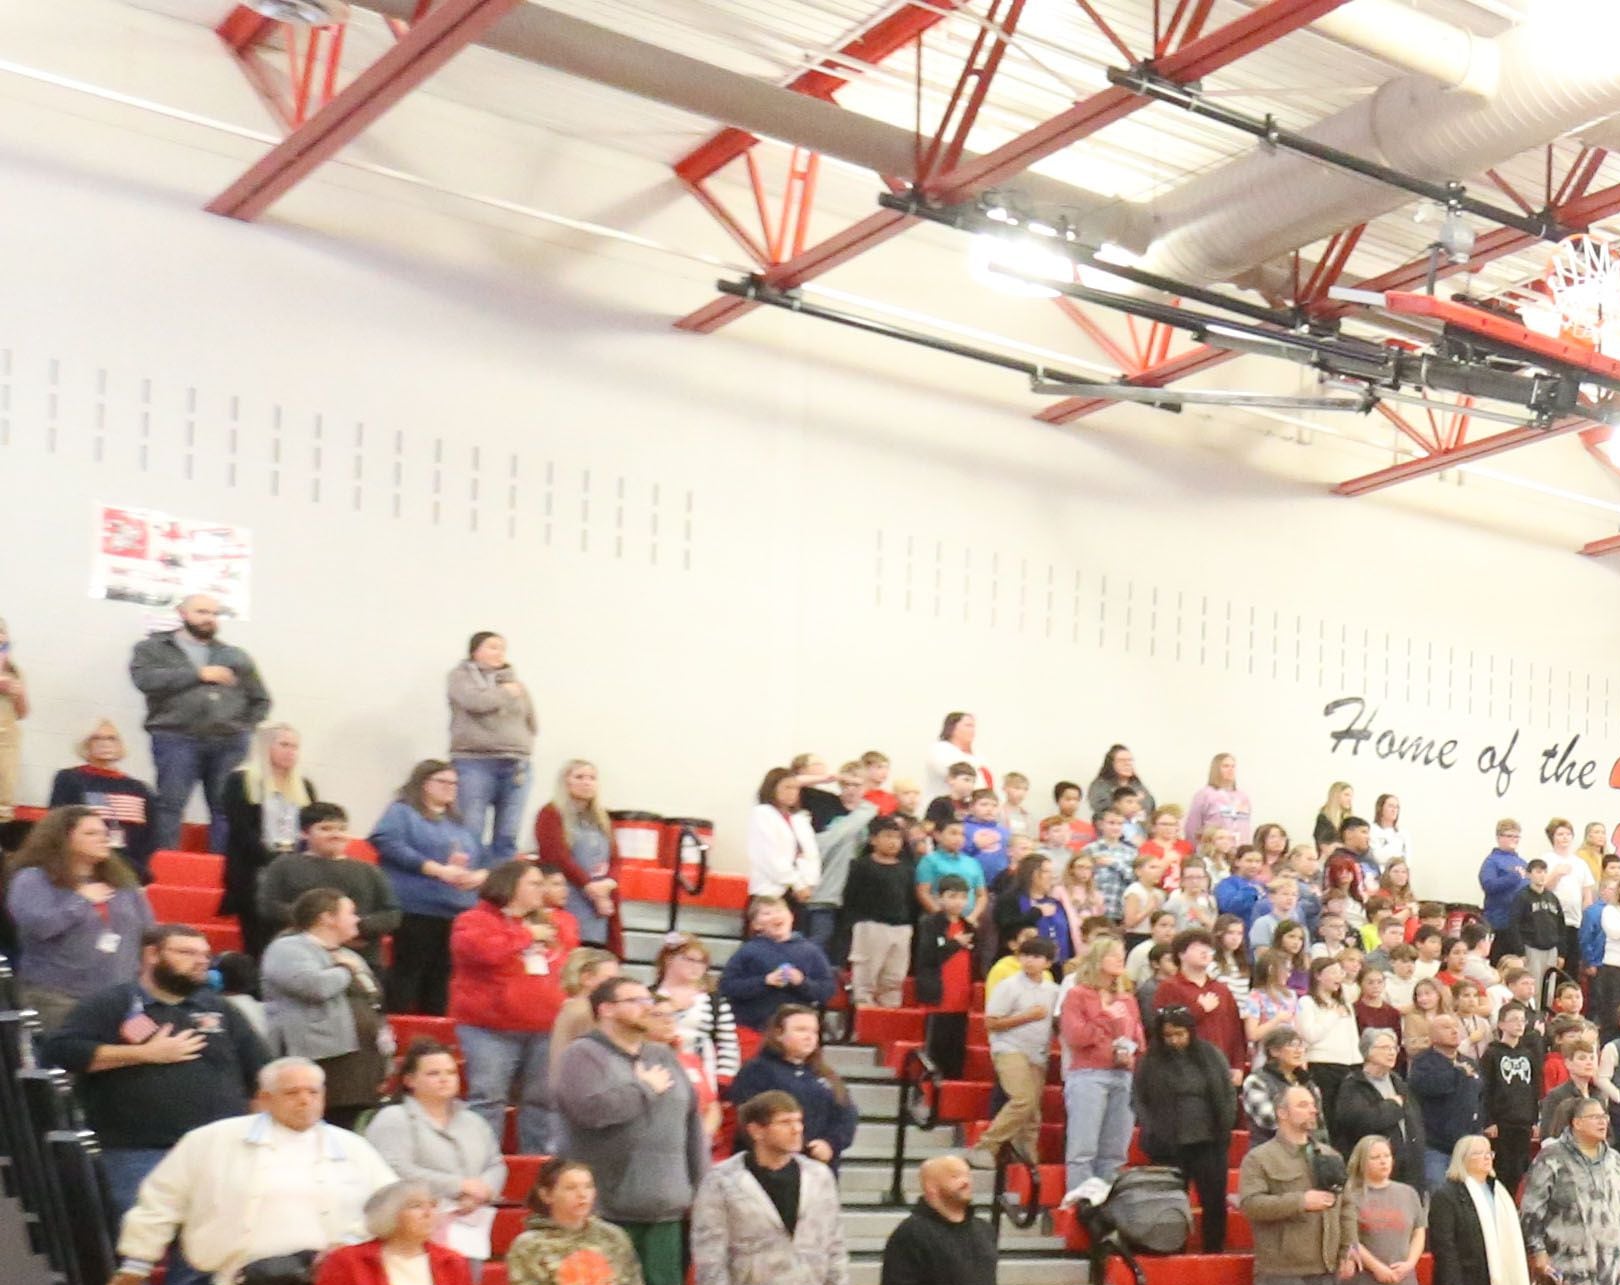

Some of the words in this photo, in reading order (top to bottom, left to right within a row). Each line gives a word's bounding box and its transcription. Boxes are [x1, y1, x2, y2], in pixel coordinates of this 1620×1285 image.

[1323, 696, 1459, 769] Home
[1478, 728, 1520, 797] of
[1539, 734, 1597, 789] the
